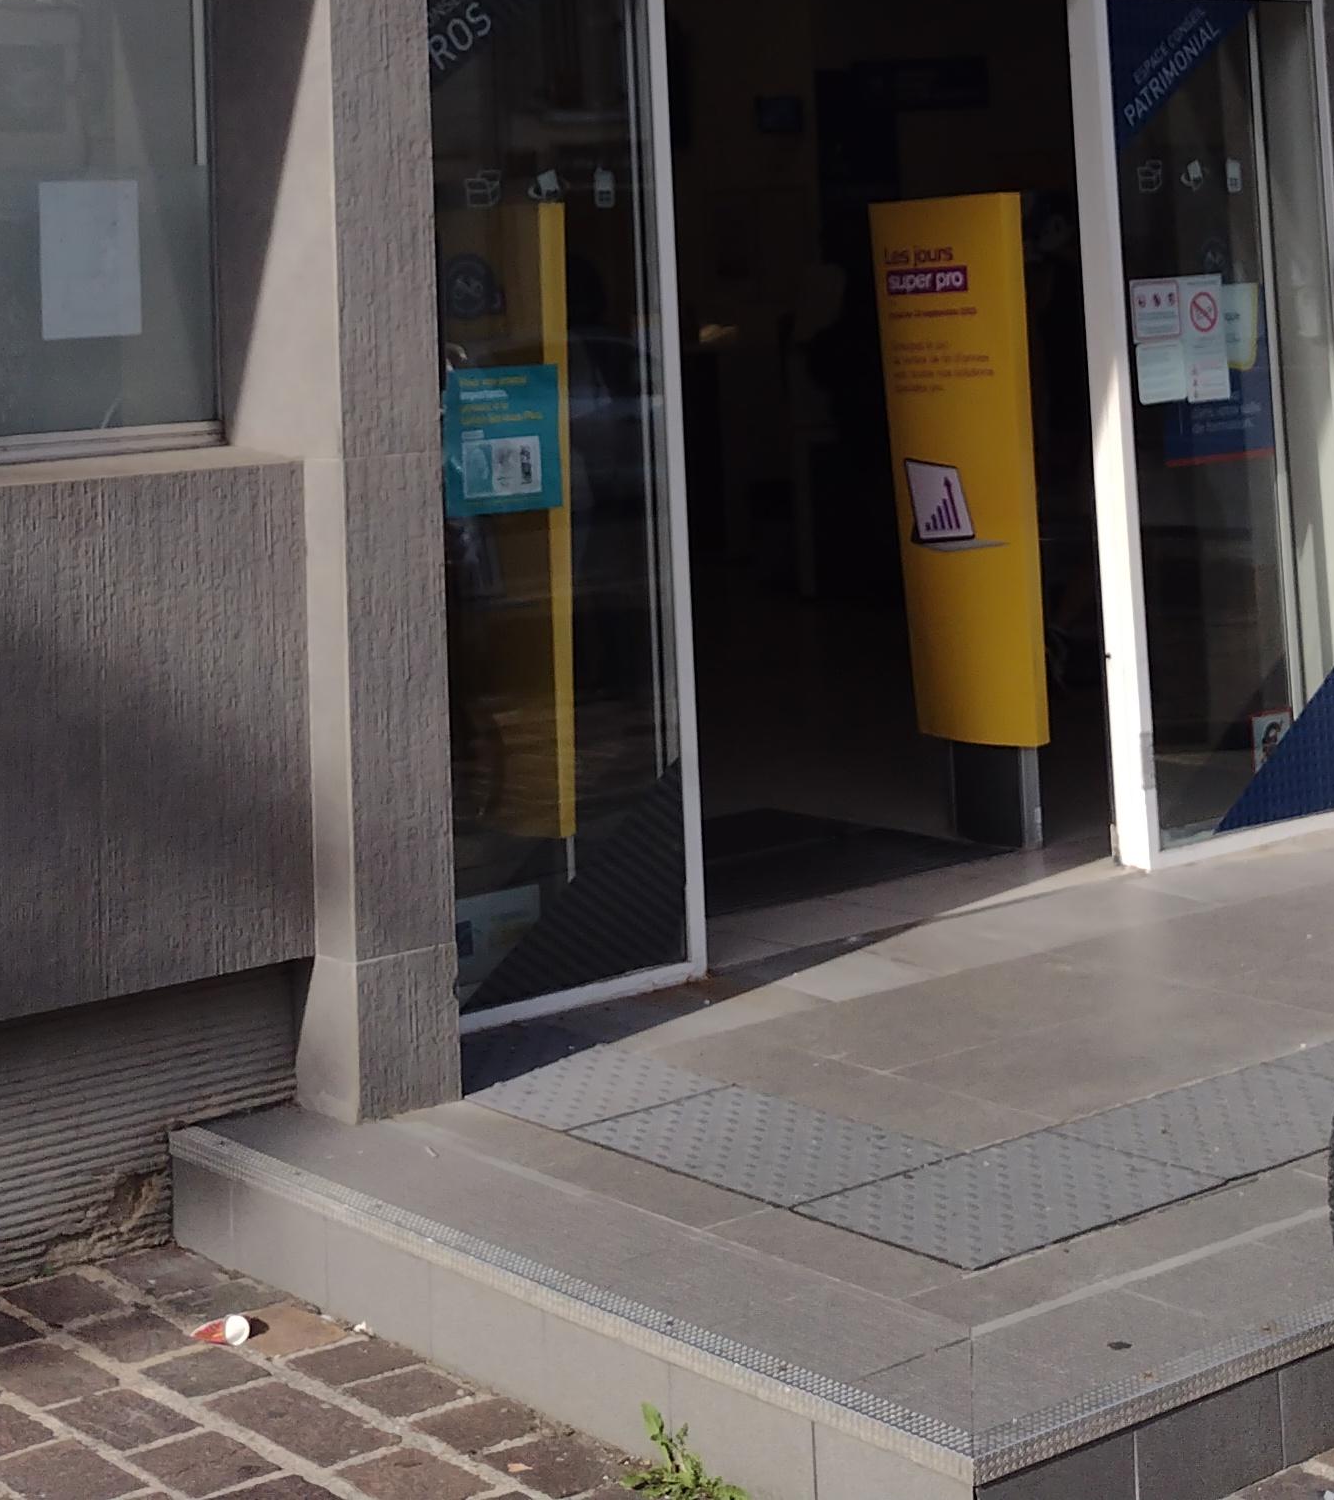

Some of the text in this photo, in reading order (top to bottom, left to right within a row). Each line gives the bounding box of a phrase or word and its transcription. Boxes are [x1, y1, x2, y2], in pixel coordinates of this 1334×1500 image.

[1123, 19, 1221, 127] PATRIMONIAL
[1132, 41, 1170, 86] ESPACE
[884, 245, 954, 267] Les jours
[888, 270, 963, 293] super pro
